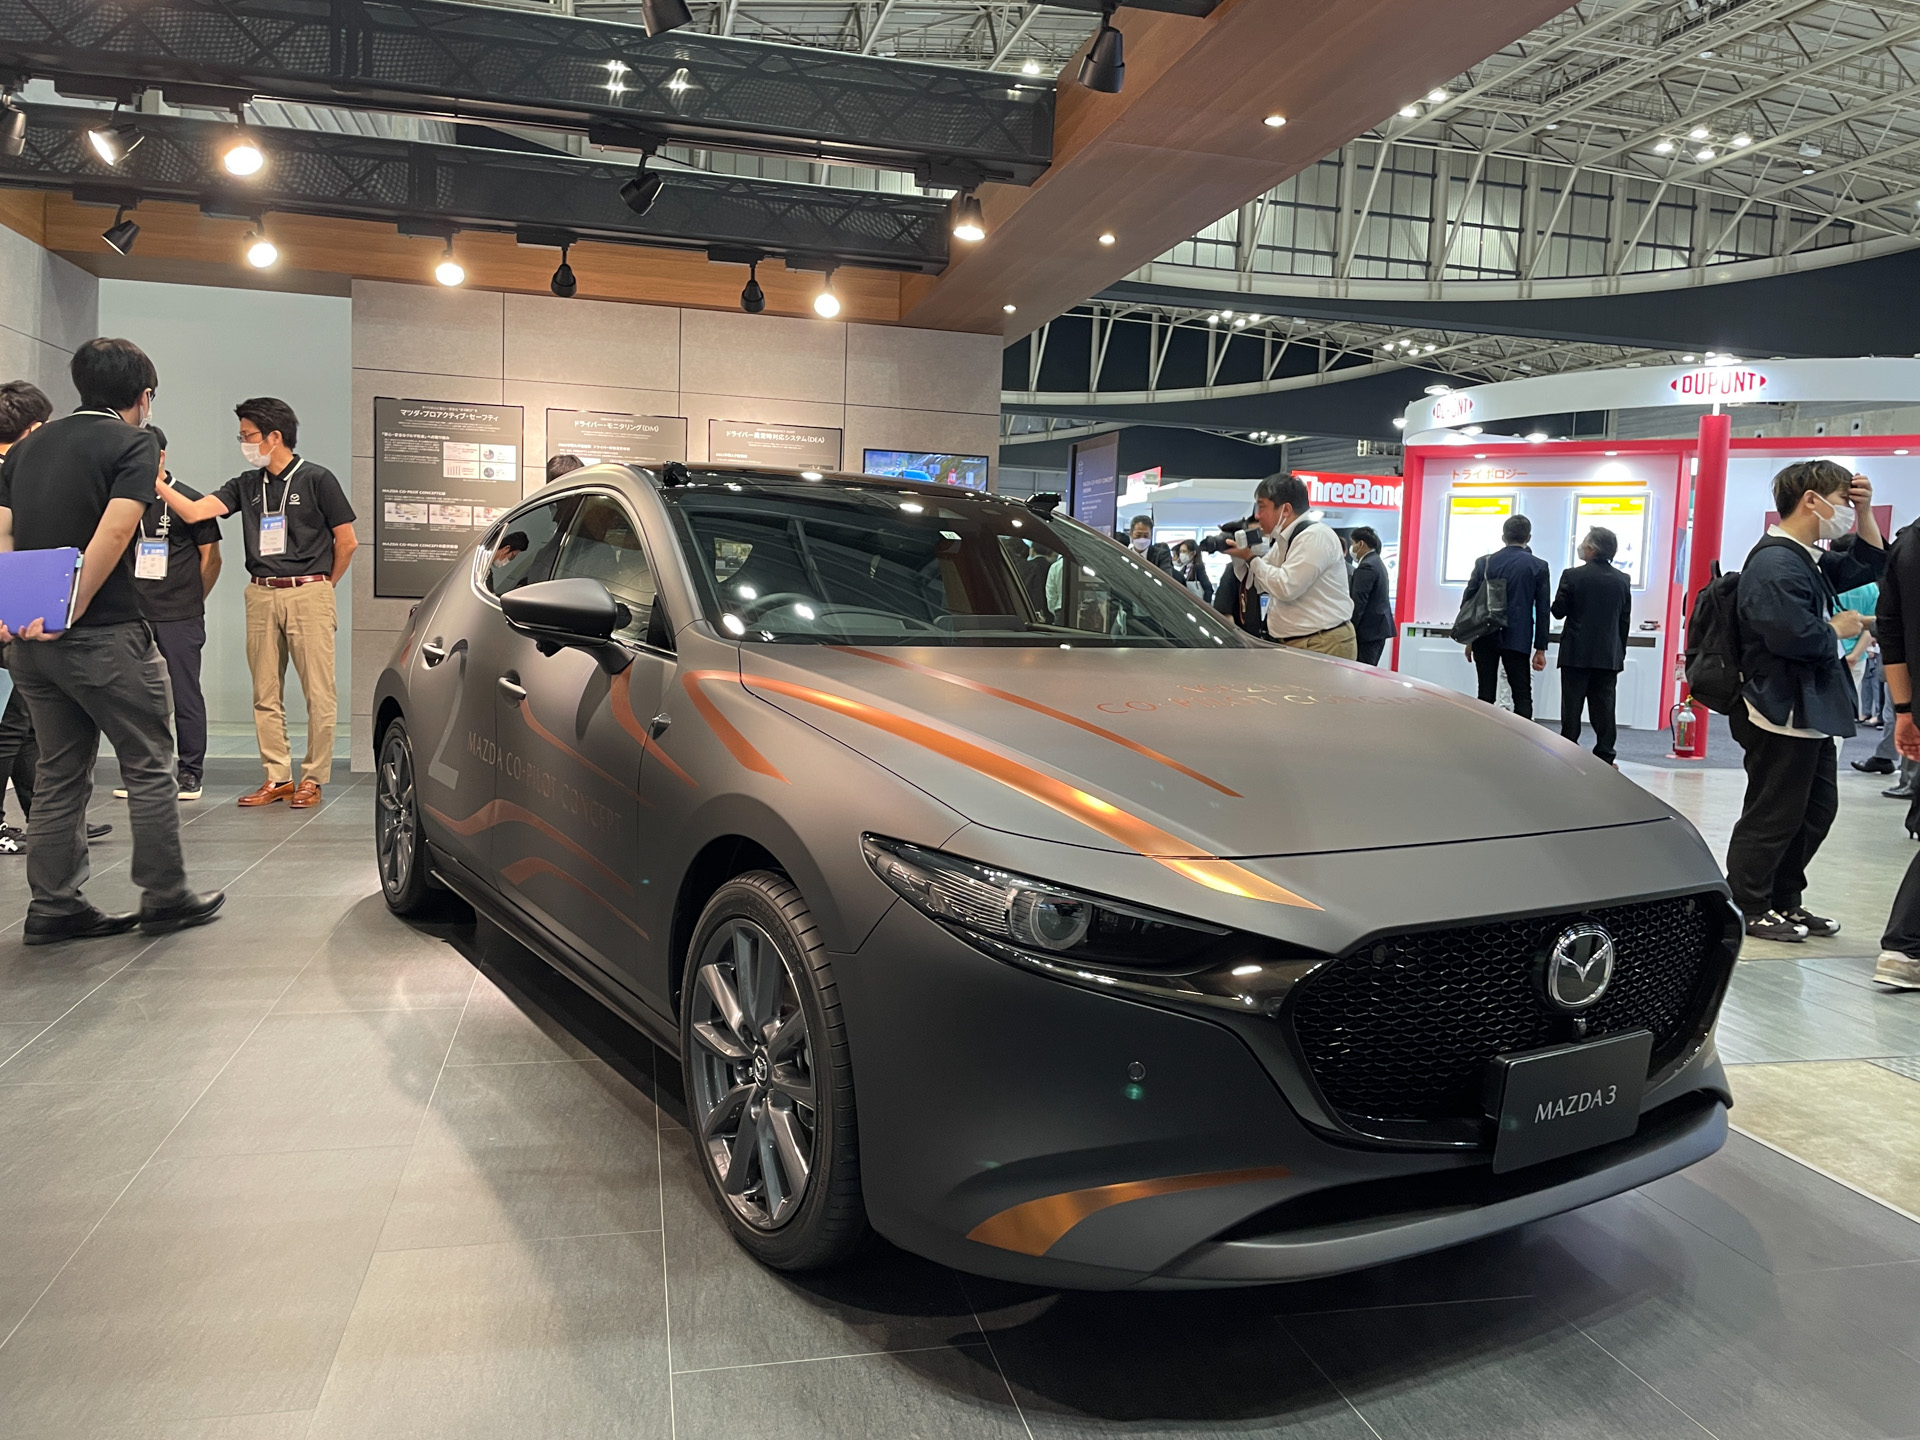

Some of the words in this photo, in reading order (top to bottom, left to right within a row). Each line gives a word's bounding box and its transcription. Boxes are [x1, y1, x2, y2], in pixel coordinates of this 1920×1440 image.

[1682, 371, 1756, 395] DUPONT
[467, 730, 503, 771] MAZDA
[506, 751, 557, 800] CO-PILOT
